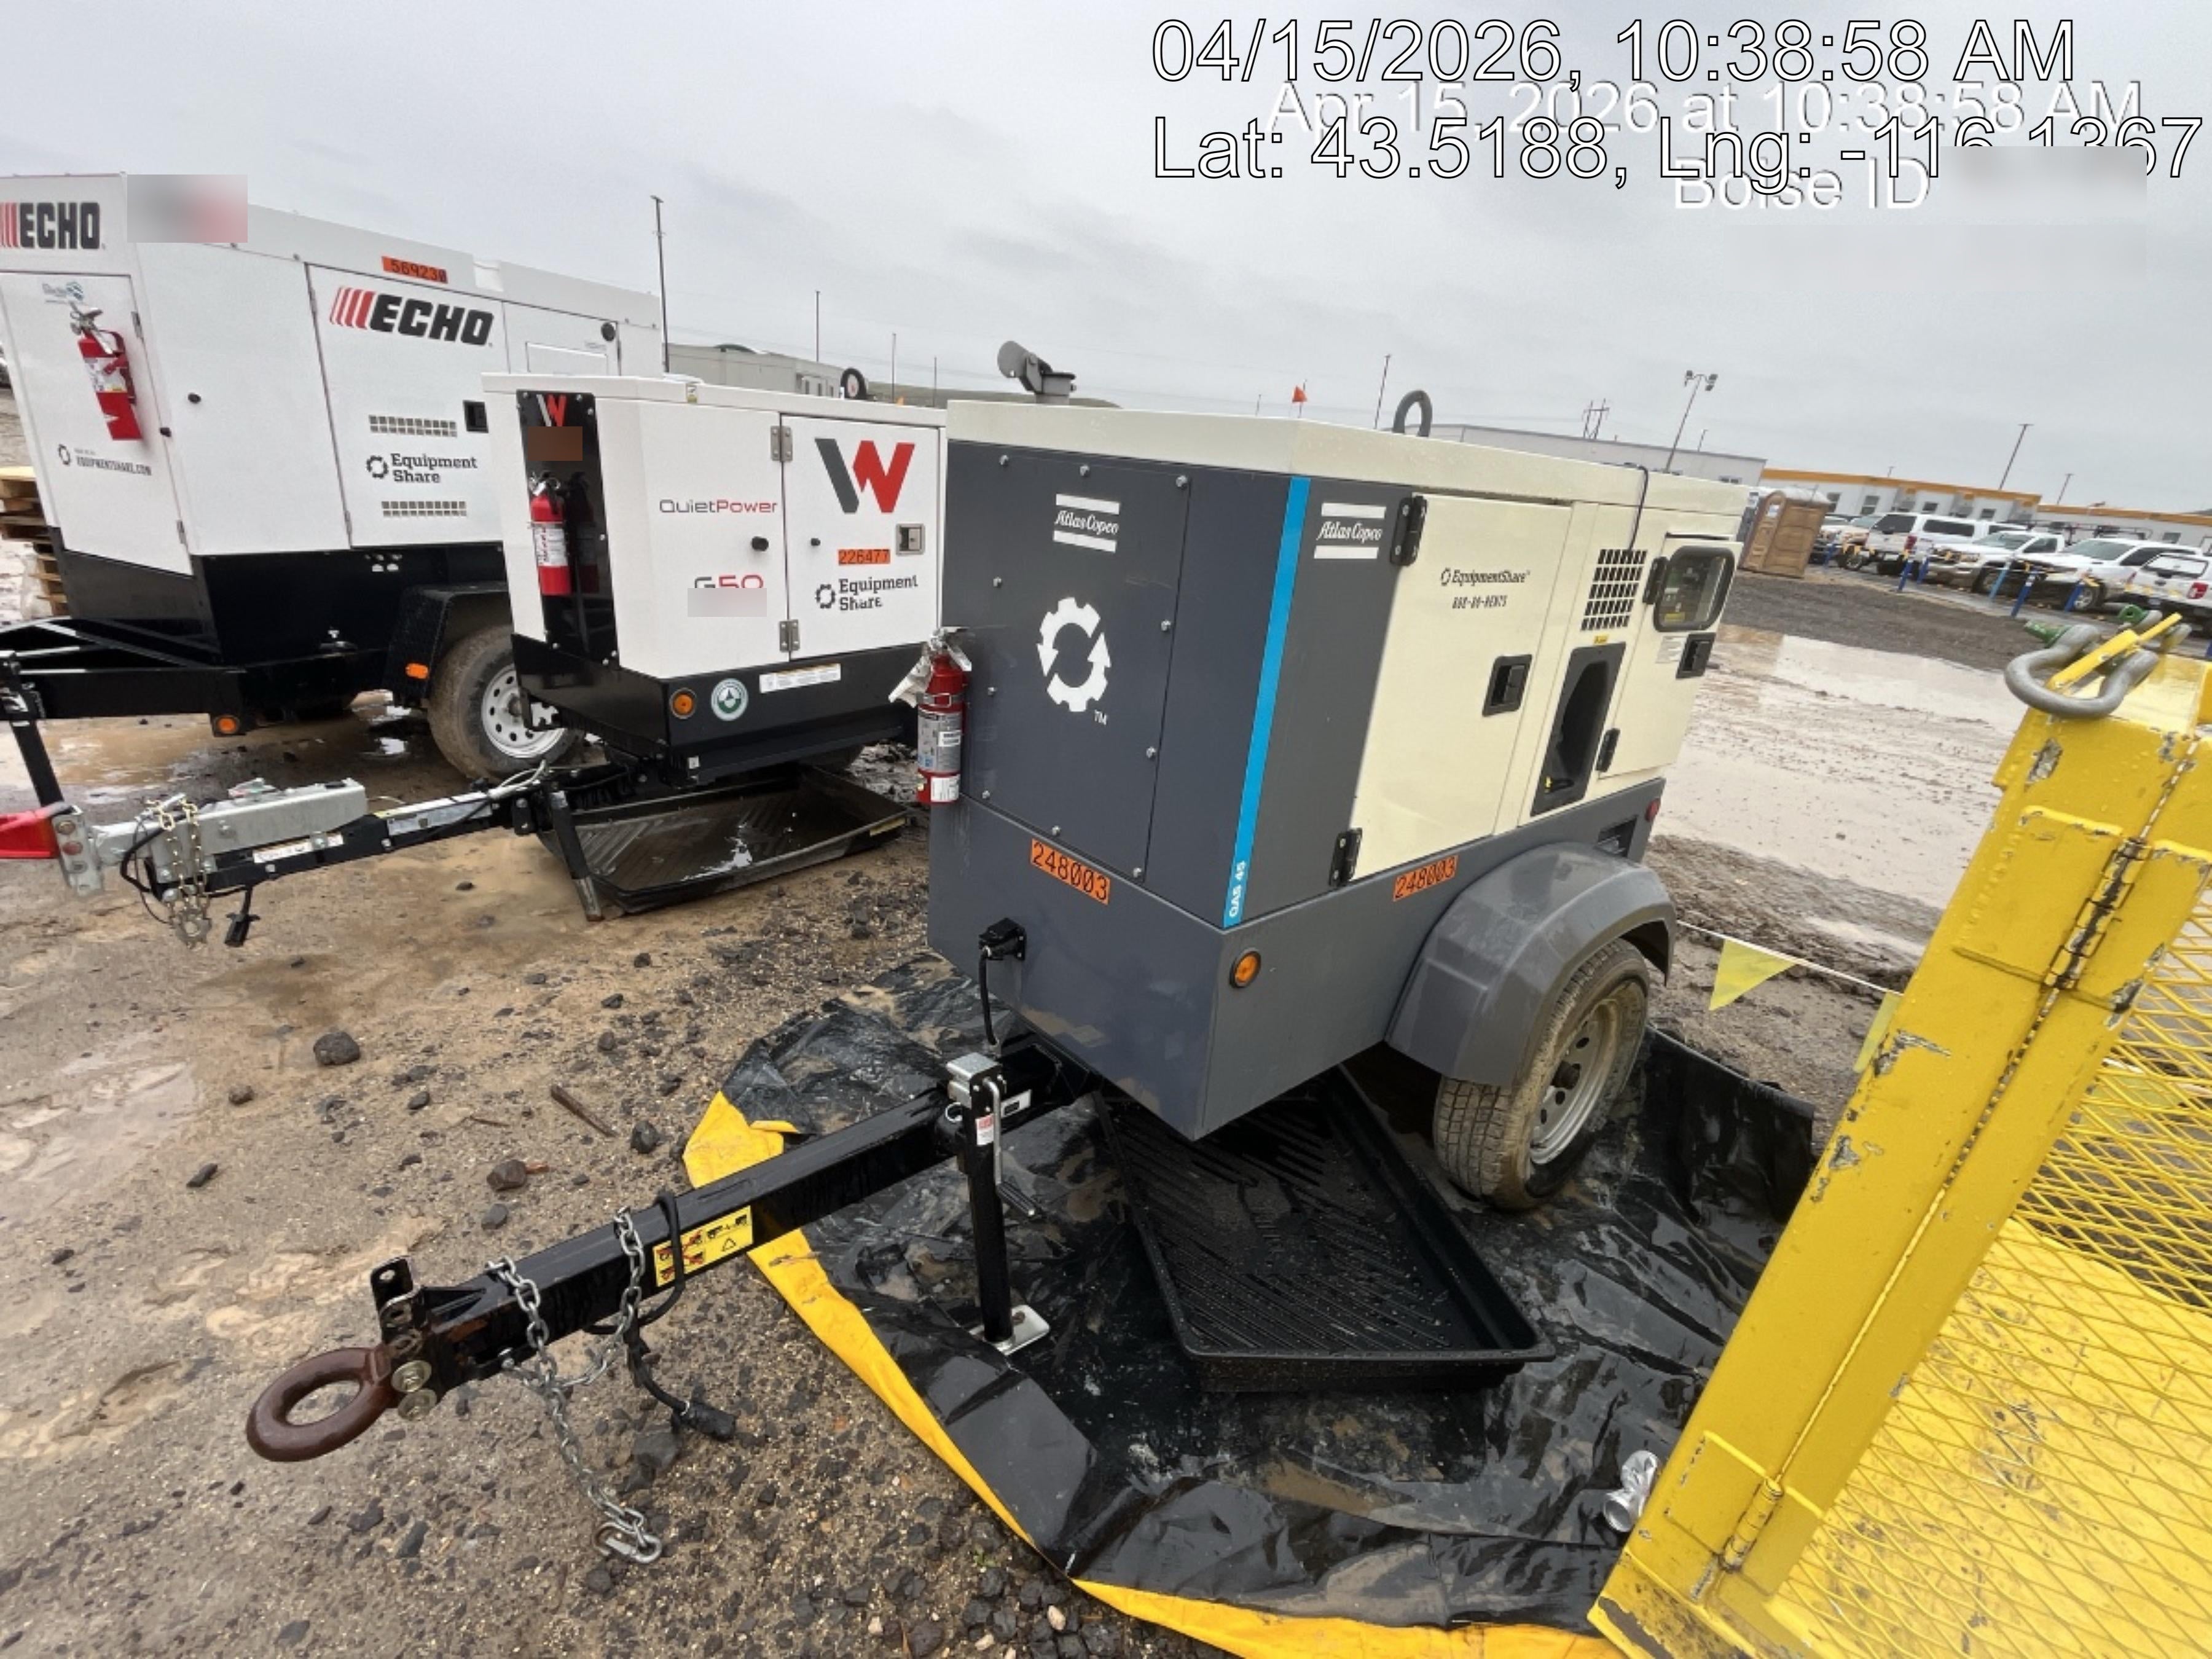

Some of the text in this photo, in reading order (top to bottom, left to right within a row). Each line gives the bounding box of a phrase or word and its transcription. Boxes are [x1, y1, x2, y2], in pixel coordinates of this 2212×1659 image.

[20, 202, 101, 249] ECHO
[370, 294, 495, 346] ECHO
[390, 453, 478, 470] Equipment
[393, 469, 441, 484] Share
[659, 499, 777, 513] QuietPower
[839, 549, 890, 564] 226477
[839, 575, 918, 595] Equipment
[839, 597, 882, 611] Share
[1033, 842, 1107, 900] 248003
[1395, 856, 1455, 899] 248003
